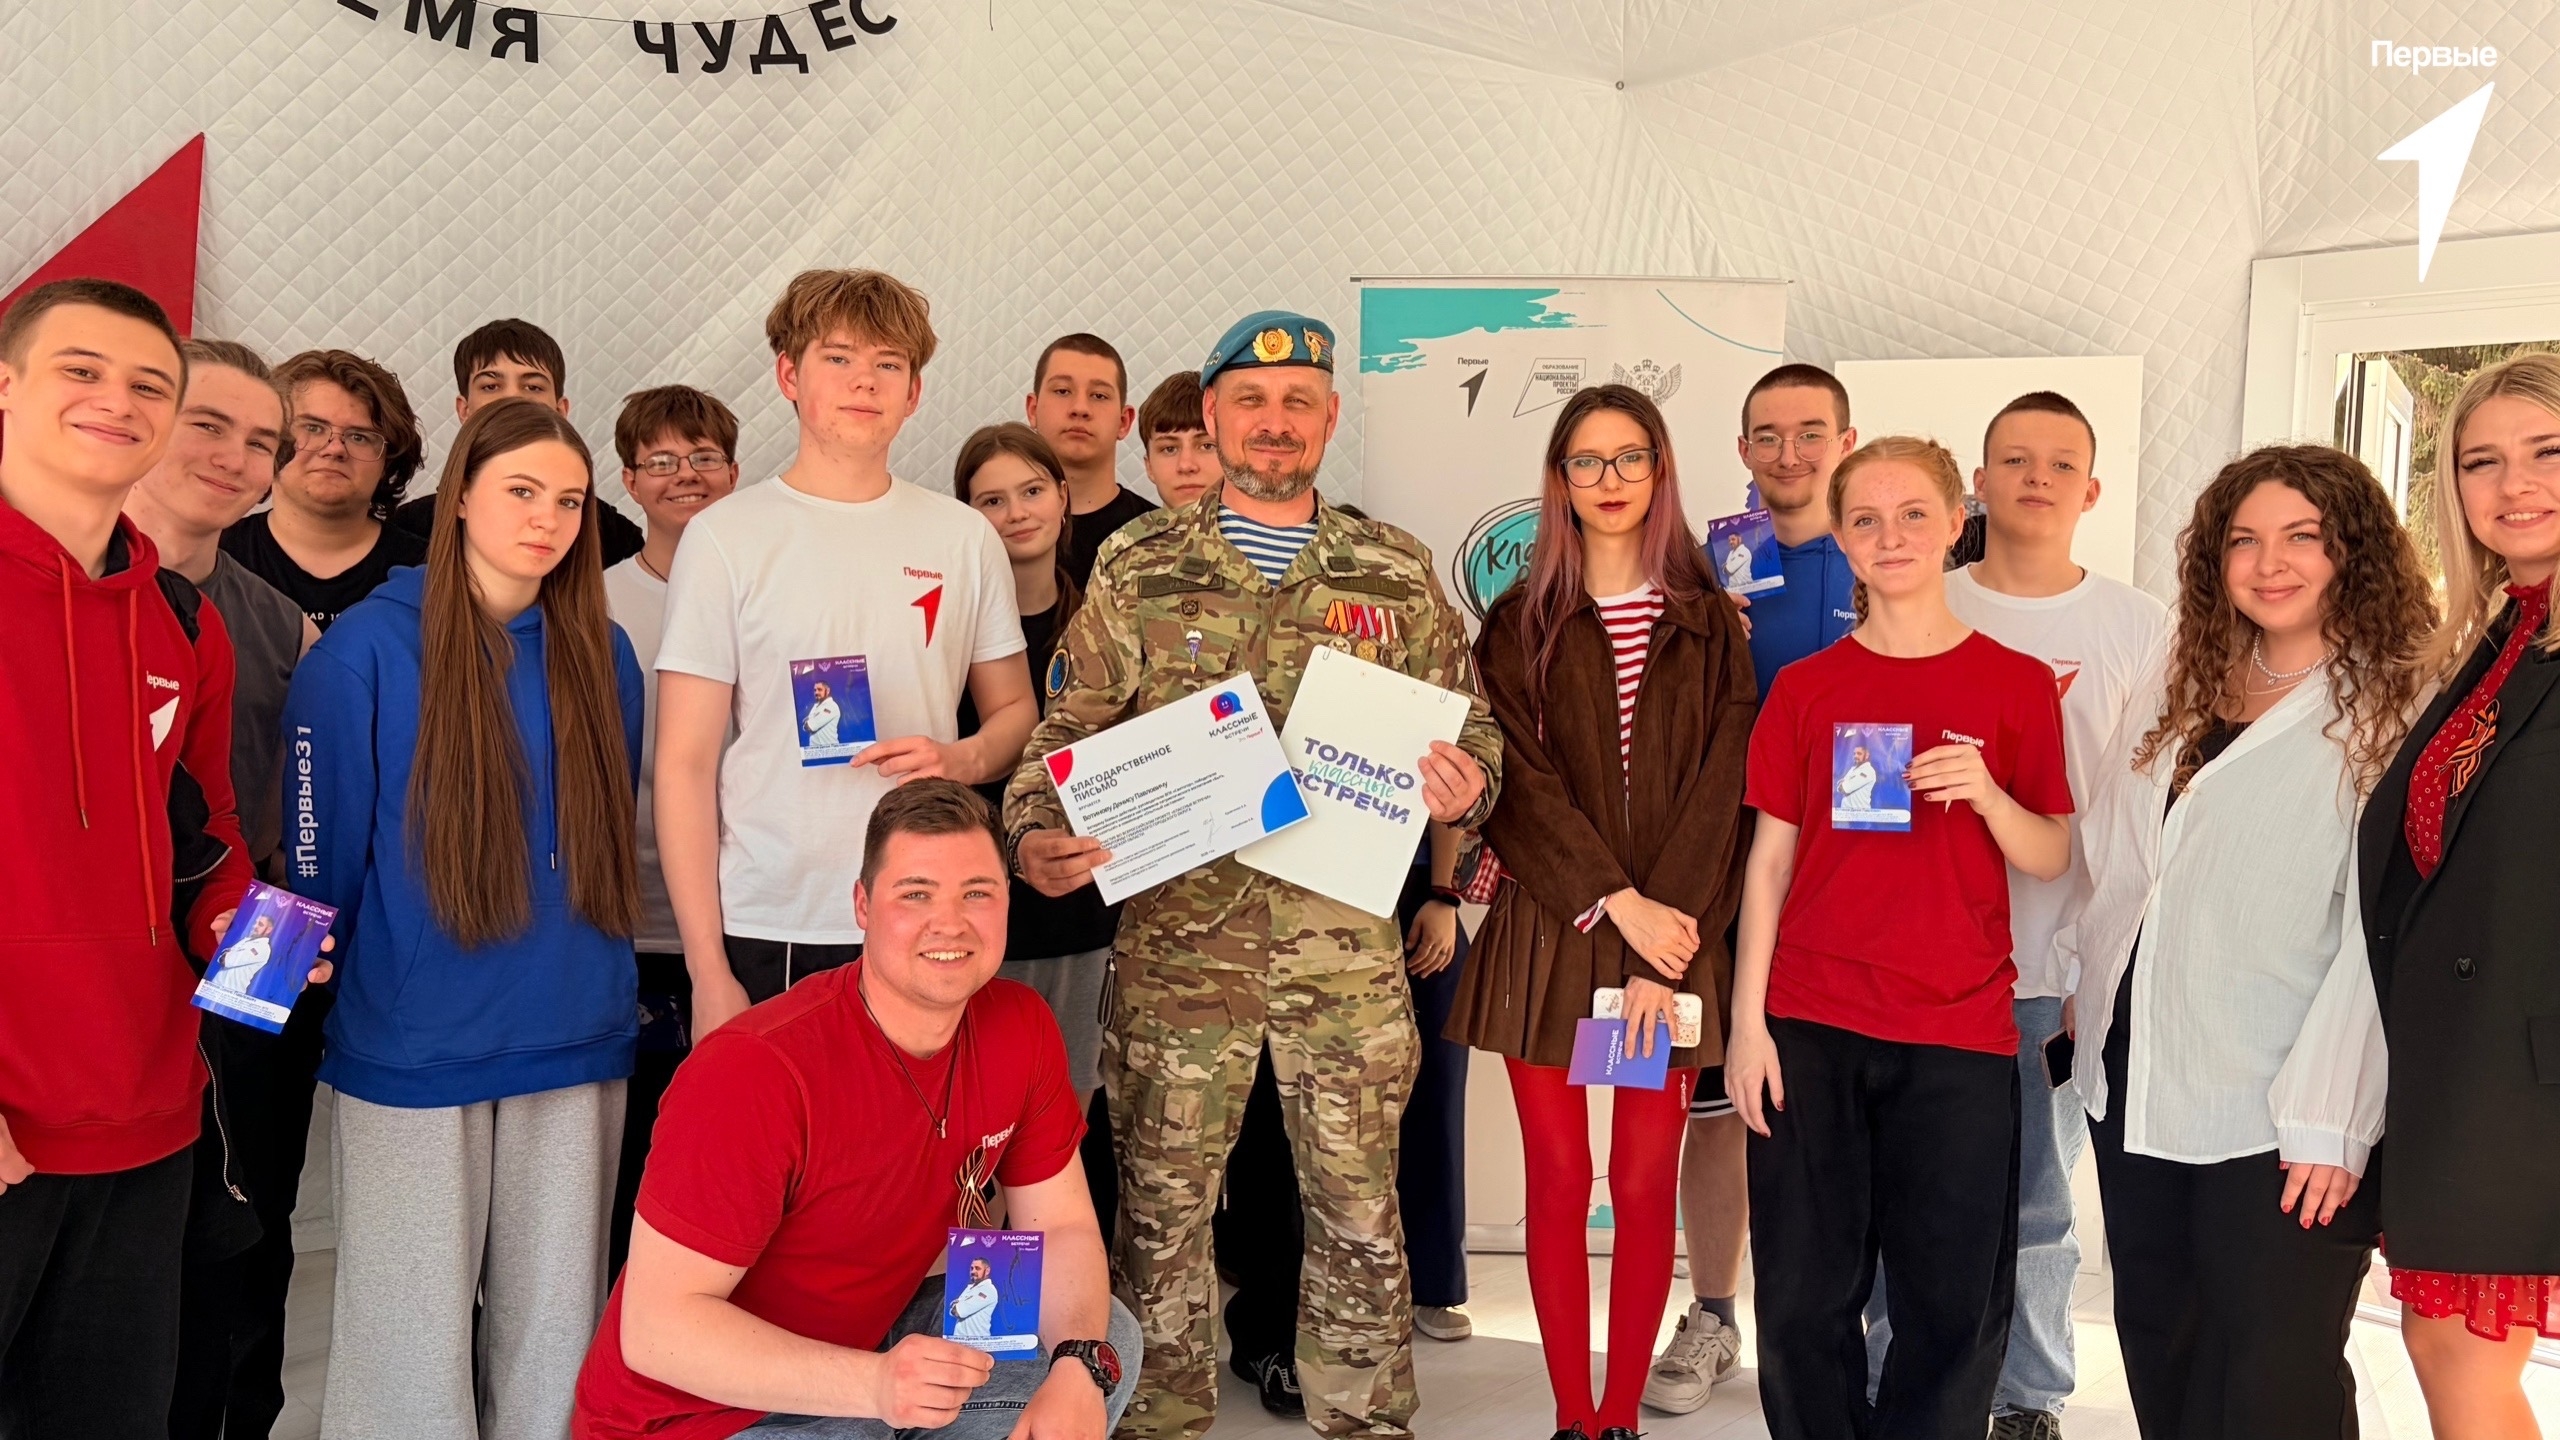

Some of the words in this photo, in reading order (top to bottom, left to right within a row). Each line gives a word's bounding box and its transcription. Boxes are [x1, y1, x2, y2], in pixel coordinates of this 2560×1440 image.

[337, 0, 539, 63] МЯ
[633, 0, 898, 75] ЧУДЕС
[1457, 357, 1489, 367] Первые
[903, 566, 943, 580] Первые
[2051, 658, 2082, 666] Первые
[1208, 711, 1259, 738] КЛАССНЫЕ
[1942, 729, 1985, 748] Первые
[1070, 745, 1172, 793] БЛАГОДАРСТВЕННОЕ
[1304, 736, 1415, 790] ТОЛЬКО
[1308, 759, 1395, 798] классные
[295, 725, 319, 878] #Первые31
[1074, 778, 1118, 802] ПИСЬМО
[1082, 805, 1112, 821] Вотинову
[1111, 795, 1135, 809] Денису
[1134, 781, 1168, 800] Павловичу
[1605, 1029, 1619, 1075] КЛАССНЫЕ
